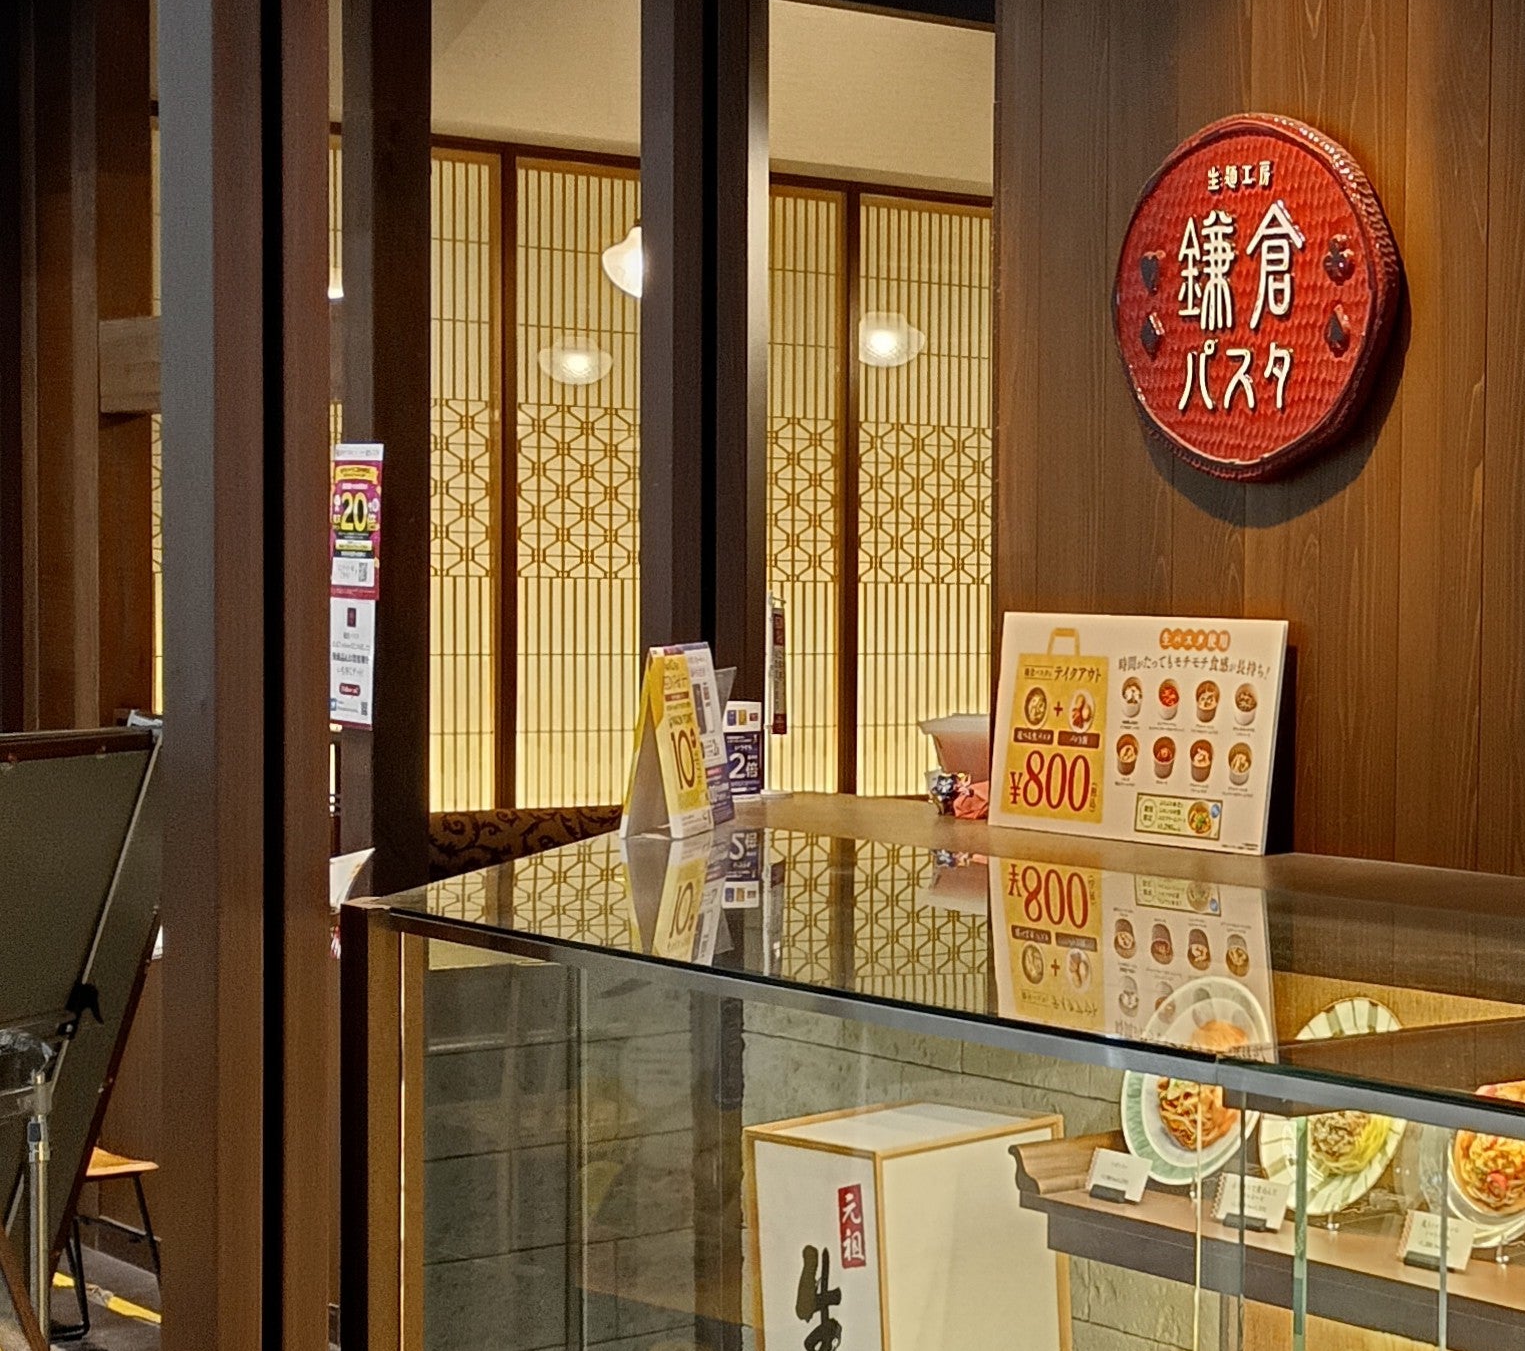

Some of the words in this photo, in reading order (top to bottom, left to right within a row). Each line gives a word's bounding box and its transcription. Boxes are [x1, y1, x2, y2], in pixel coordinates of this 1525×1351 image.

[1177, 199, 1306, 332] 鎌倉
[1177, 339, 1295, 412] パスタ
[1009, 750, 1091, 812] ¥800
[841, 1192, 866, 1262] 元祖
